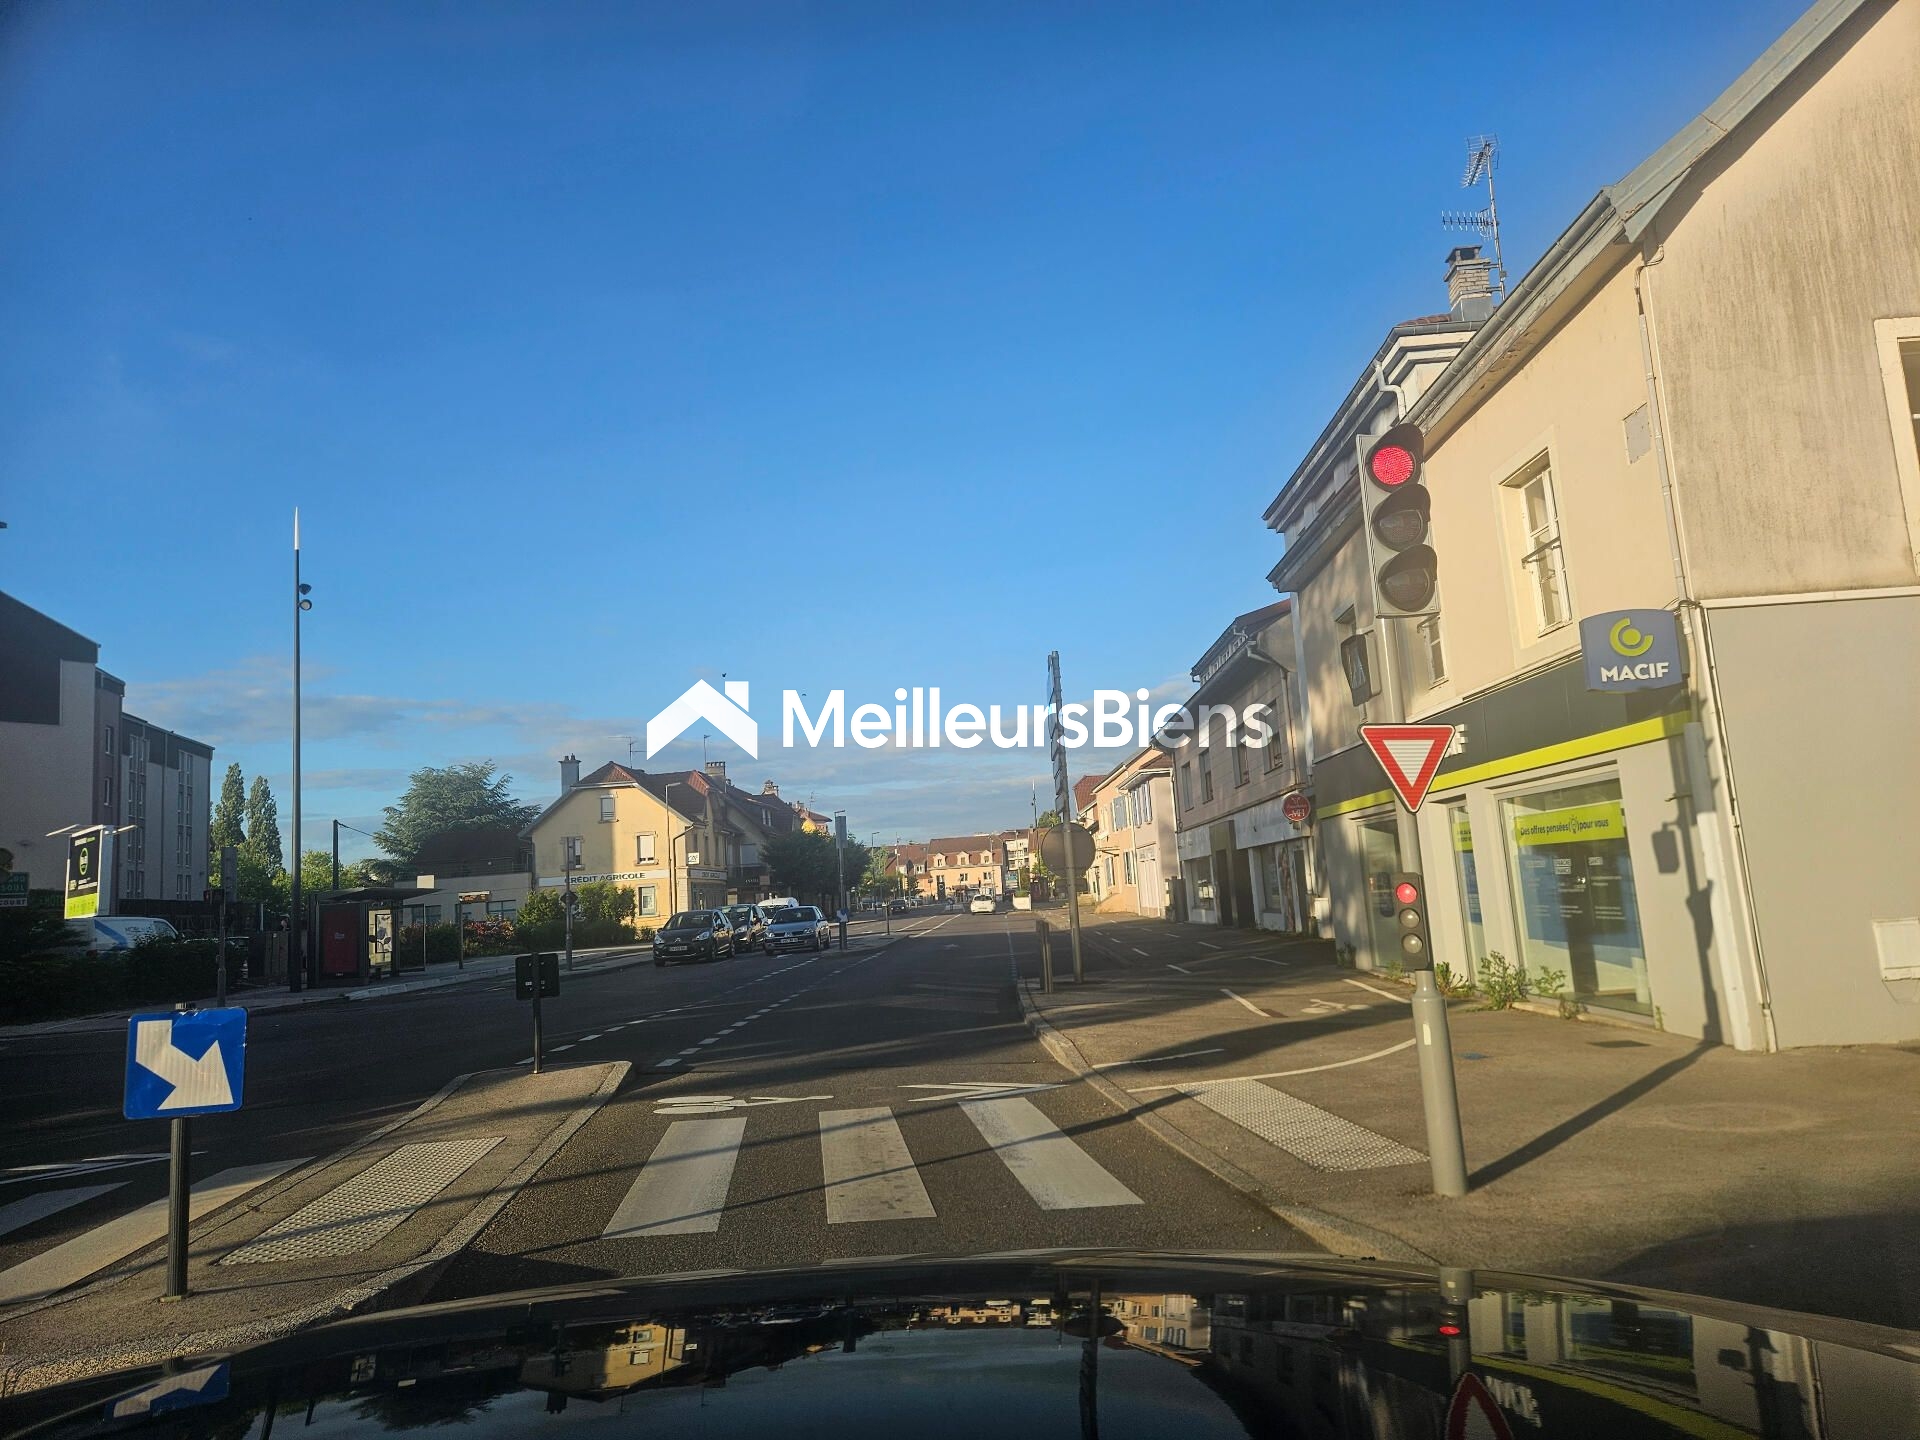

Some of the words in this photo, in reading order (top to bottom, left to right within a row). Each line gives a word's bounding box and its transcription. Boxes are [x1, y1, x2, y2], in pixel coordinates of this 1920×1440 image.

[1601, 662, 1669, 682] MACIF
[1531, 825, 1546, 834] offres
[1594, 819, 1609, 827] vous
[600, 873, 646, 881] AGRICOLE
